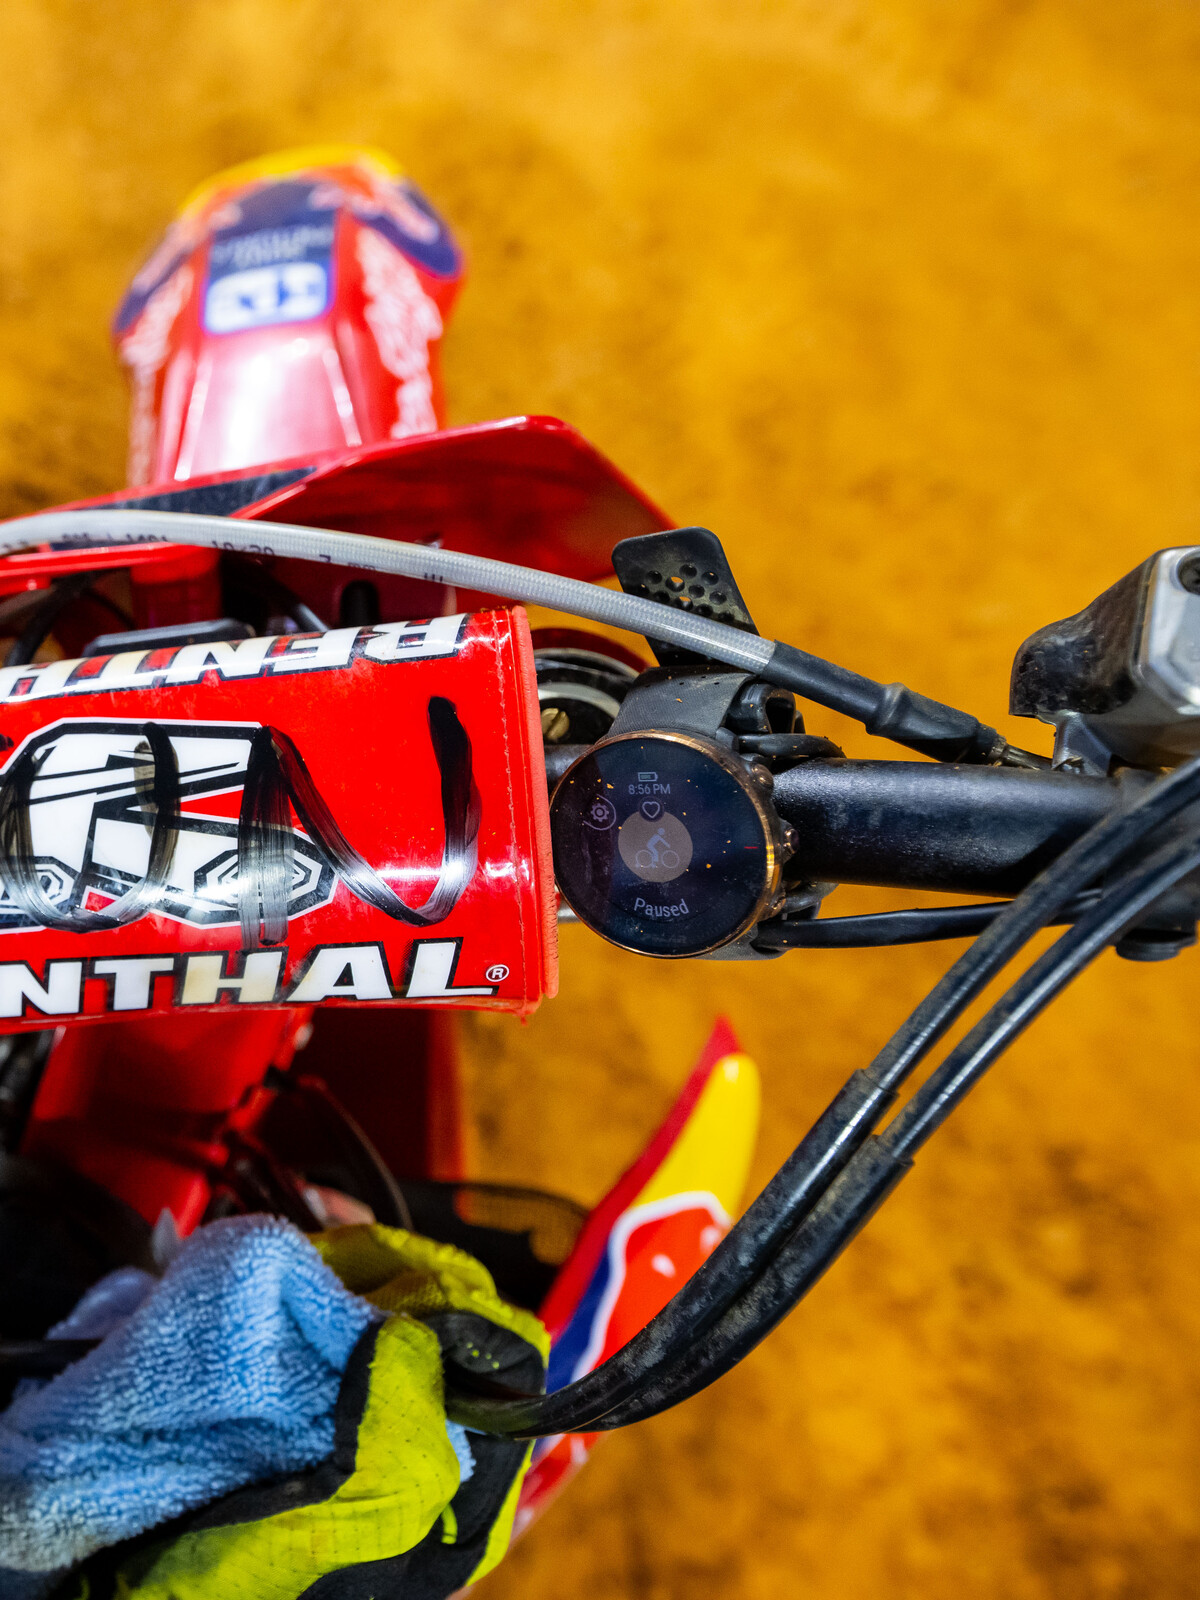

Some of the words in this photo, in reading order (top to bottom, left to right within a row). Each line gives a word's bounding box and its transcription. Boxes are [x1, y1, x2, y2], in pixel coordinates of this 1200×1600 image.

[628, 783, 651, 795] 8:56
[652, 783, 671, 795] PM
[633, 897, 689, 918] Paused
